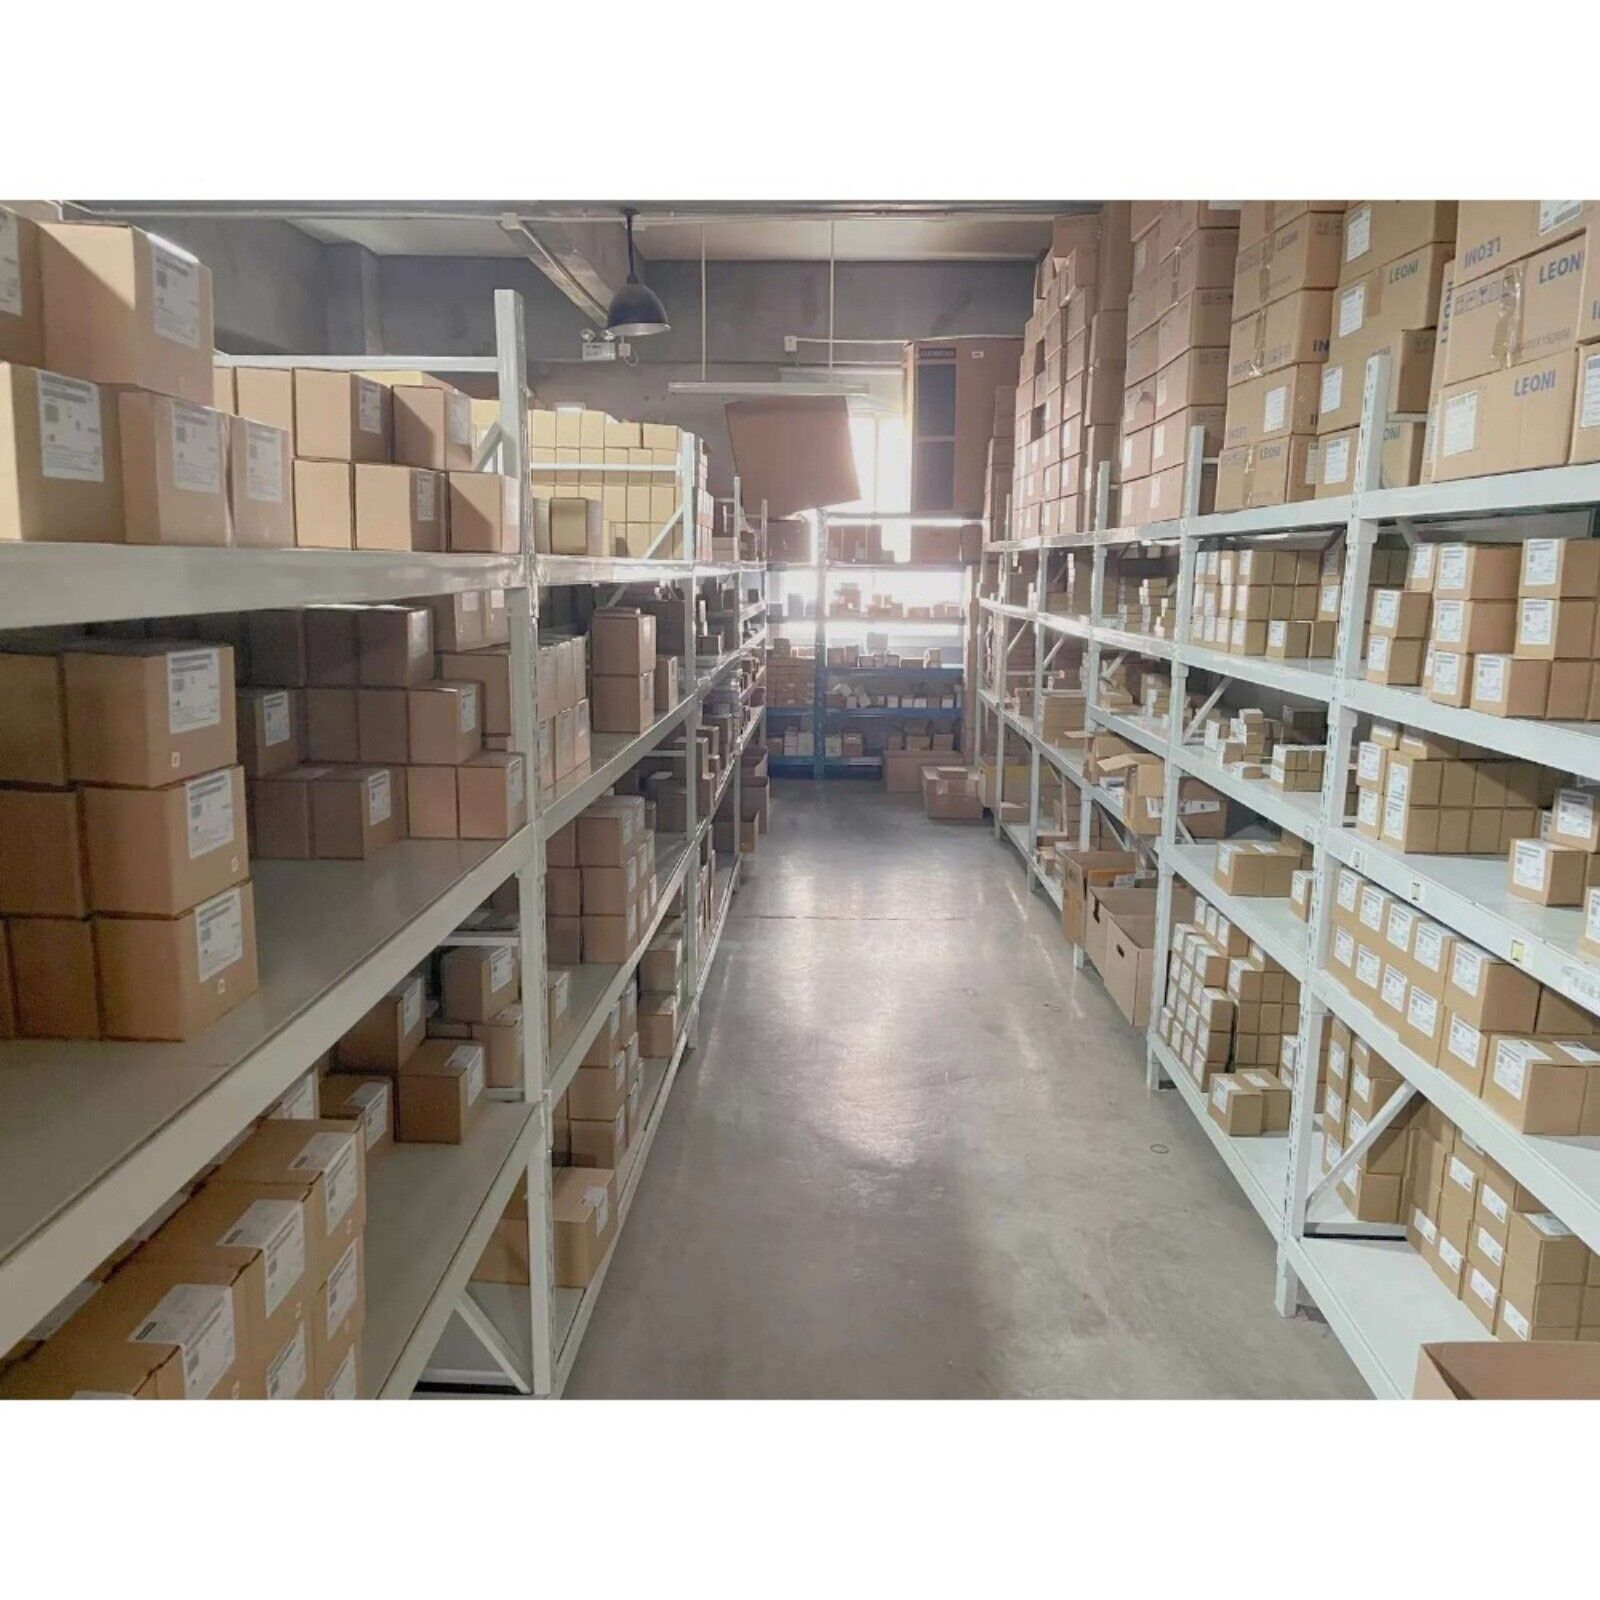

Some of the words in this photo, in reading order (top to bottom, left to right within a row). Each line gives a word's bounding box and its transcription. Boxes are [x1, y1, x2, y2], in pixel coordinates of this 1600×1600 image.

[1389, 258, 1420, 284] LEONI
[1514, 369, 1557, 397] LEONI
[1383, 424, 1401, 441] ONI
